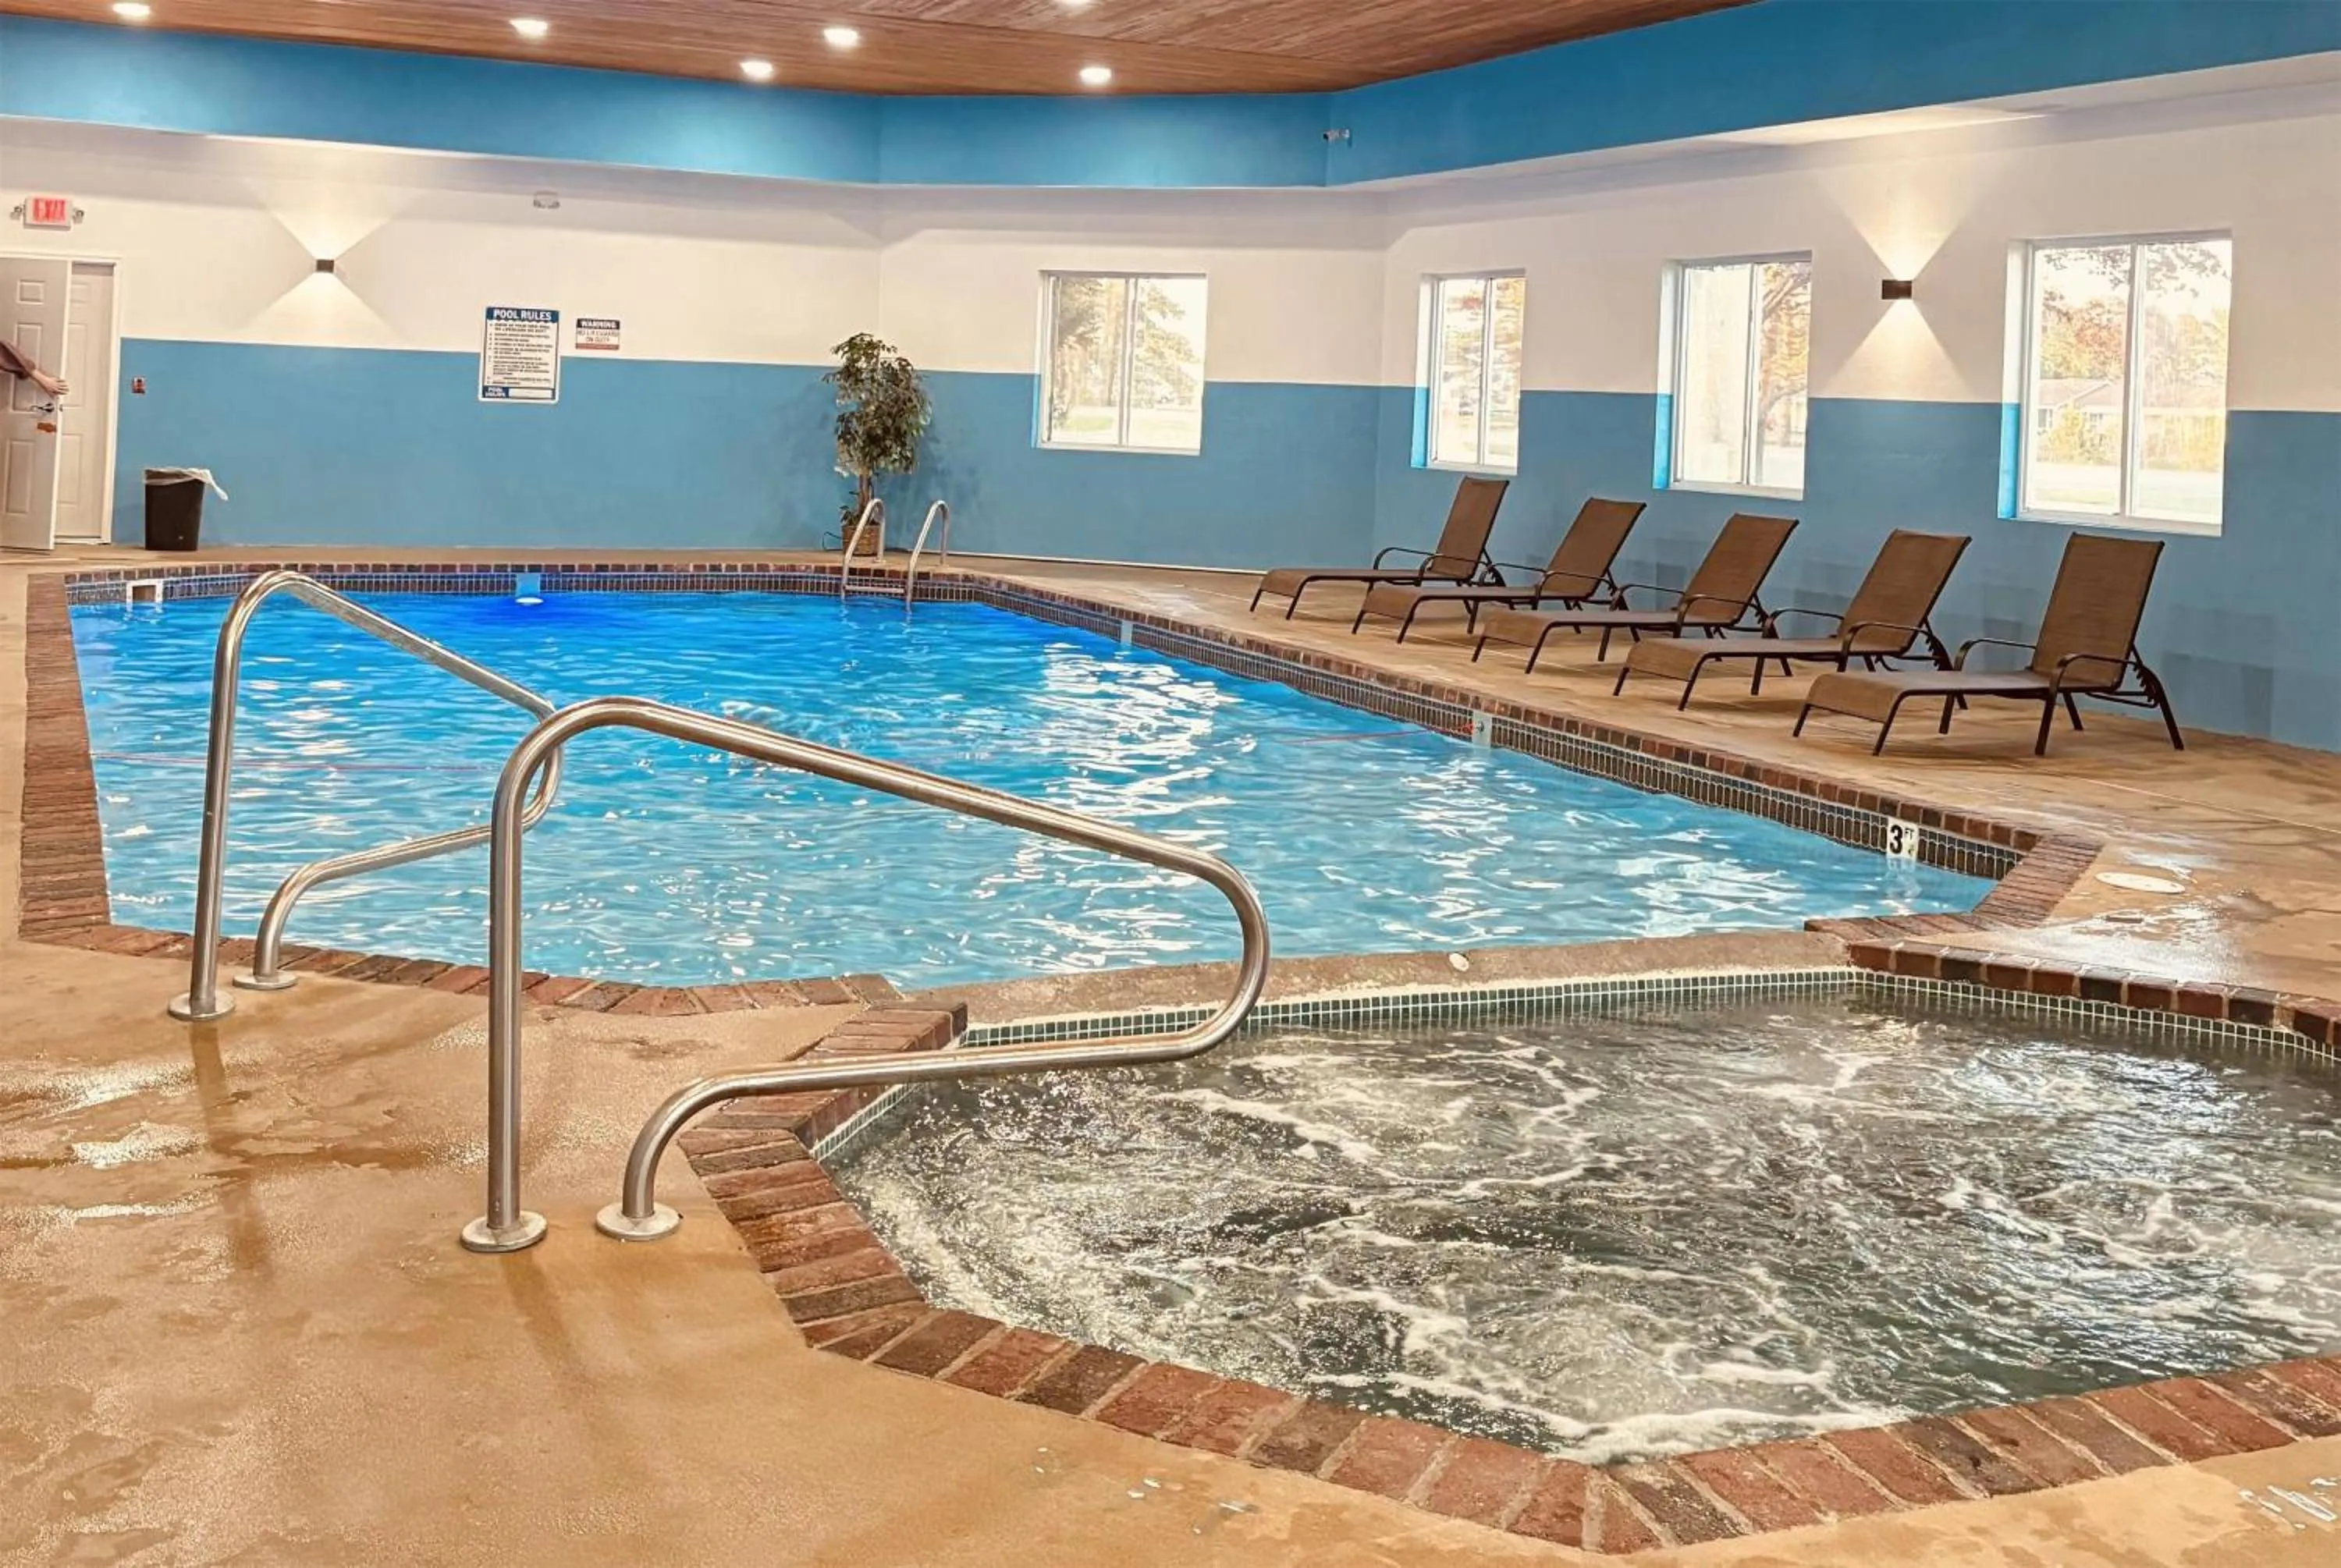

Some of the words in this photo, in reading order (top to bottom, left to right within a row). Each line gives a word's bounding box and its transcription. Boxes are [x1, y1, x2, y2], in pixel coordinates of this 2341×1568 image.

[34, 199, 66, 222] EXIT
[494, 309, 519, 318] POOL
[520, 310, 551, 321] RULES
[1890, 824, 1902, 854] 3
[1905, 827, 1915, 840] FT
